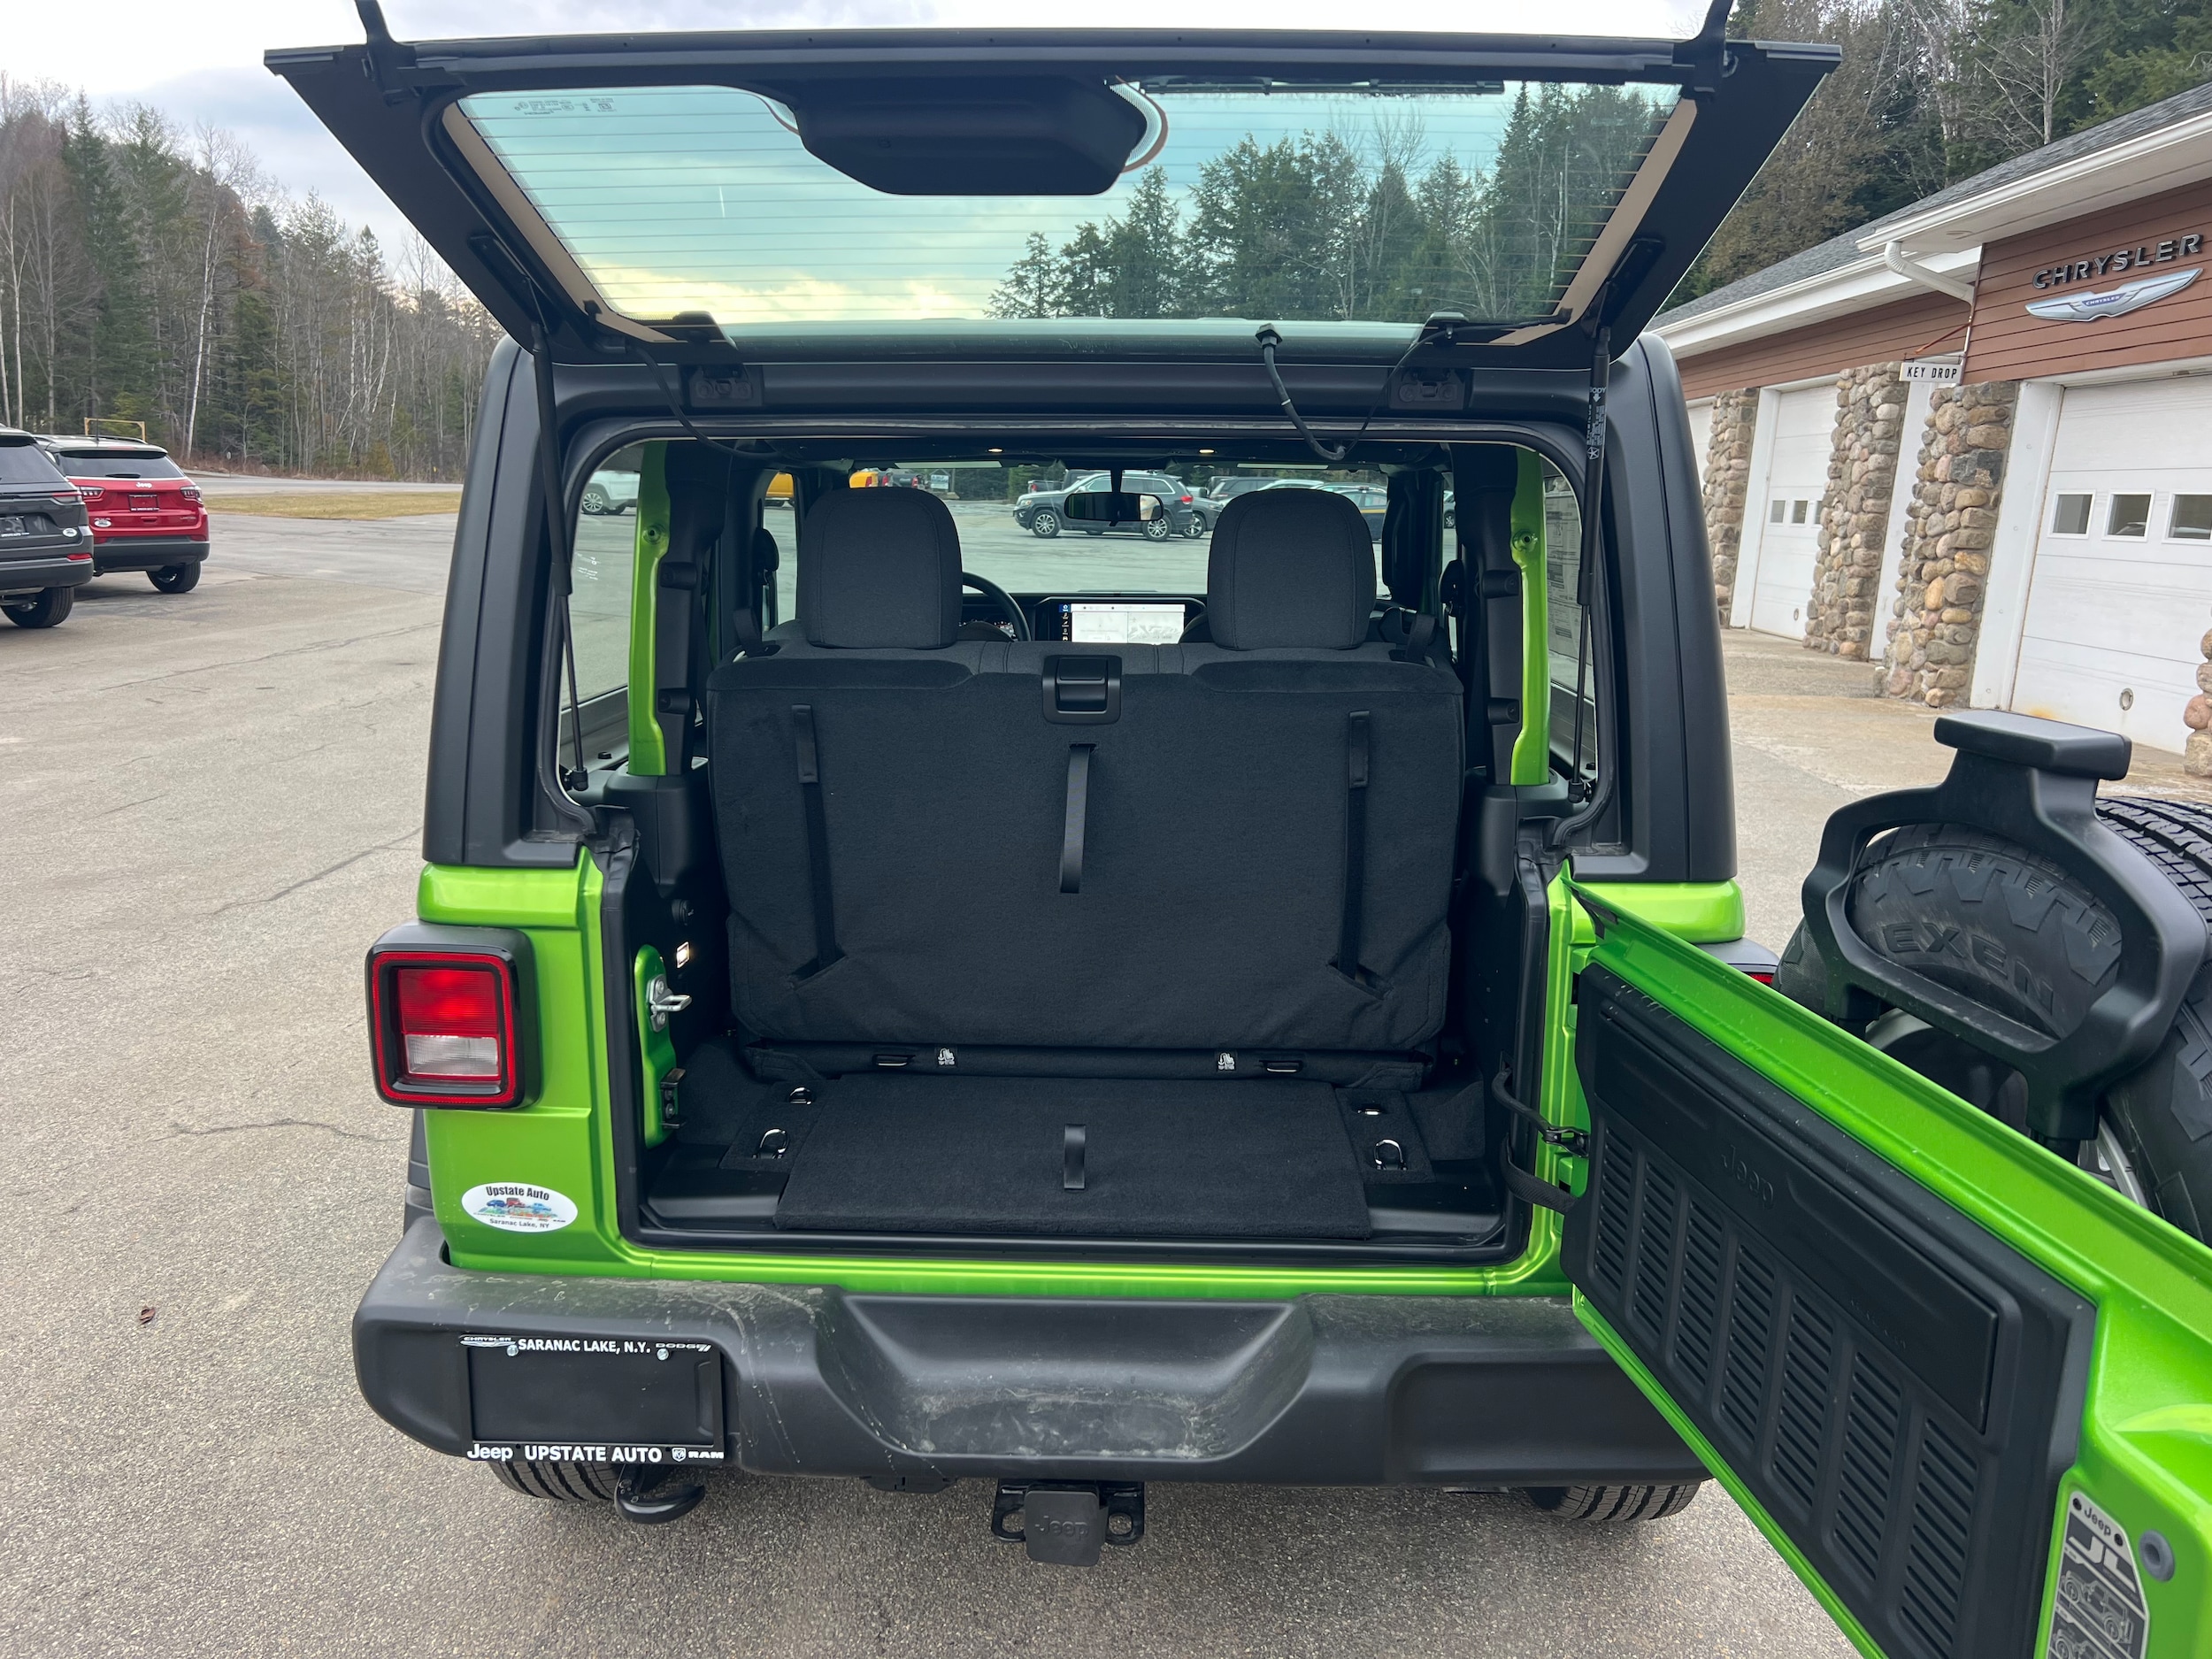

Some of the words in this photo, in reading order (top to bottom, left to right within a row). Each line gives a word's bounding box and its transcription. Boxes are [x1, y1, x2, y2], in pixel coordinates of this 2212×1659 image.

[2033, 234, 2200, 289] CHRYSLER
[2085, 295, 2121, 305] CHRYSLER
[1907, 366, 1926, 378] KEY
[1932, 367, 1957, 379] DROP
[1720, 1144, 1775, 1210] Jeep
[486, 1186, 525, 1196] Upstate
[526, 1187, 549, 1201] Auto
[489, 1217, 518, 1226] Saranac
[518, 1339, 580, 1351] SARANAC
[584, 1340, 620, 1355] LAKE,
[624, 1341, 651, 1353] N.Y.
[466, 1443, 513, 1462] Jeep
[524, 1445, 607, 1462] UPSTATE
[611, 1447, 663, 1463] AUTO
[1034, 1515, 1089, 1541] Jeep
[2084, 1508, 2111, 1536] Jeep
[2068, 1535, 2137, 1594] JL
